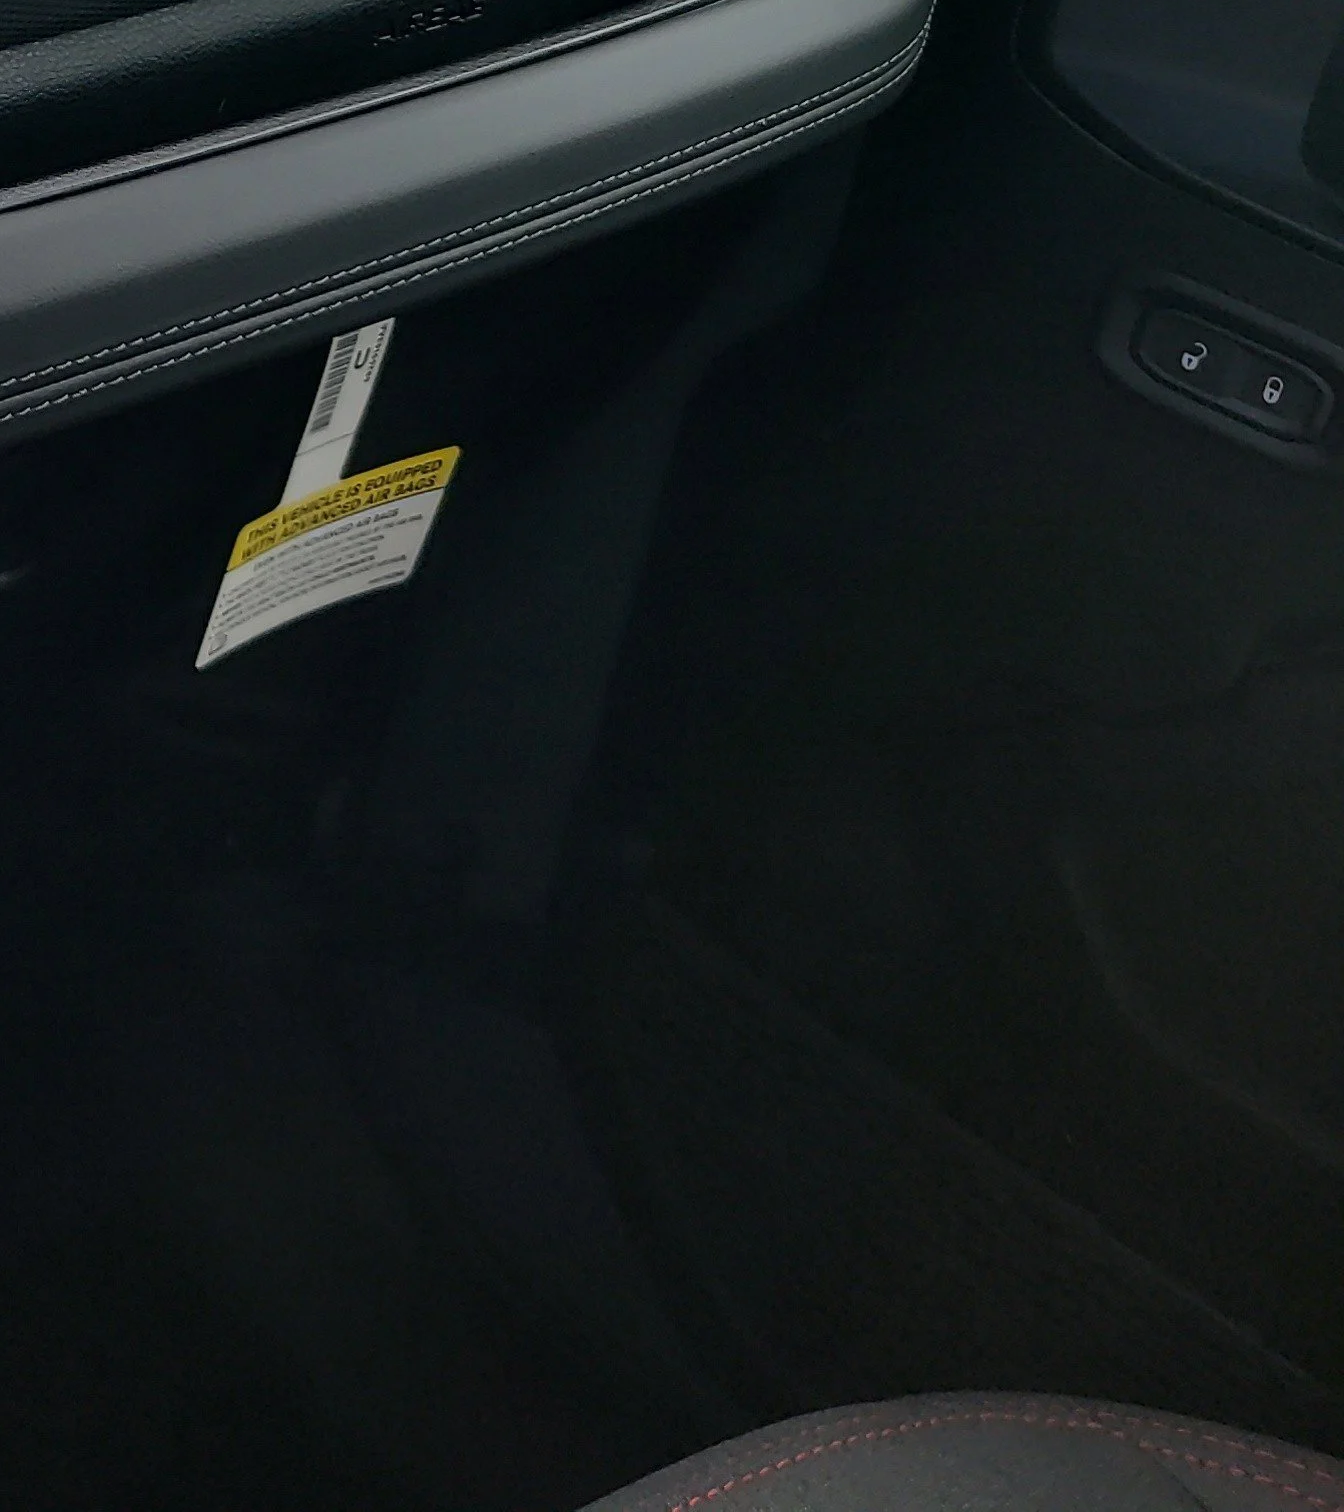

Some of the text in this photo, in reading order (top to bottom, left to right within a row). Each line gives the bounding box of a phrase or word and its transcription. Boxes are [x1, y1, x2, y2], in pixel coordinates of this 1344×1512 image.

[346, 483, 362, 498] IS
[364, 459, 443, 491] EQUIPPED
[363, 488, 390, 506] AIR
[394, 475, 436, 496] BAGS
